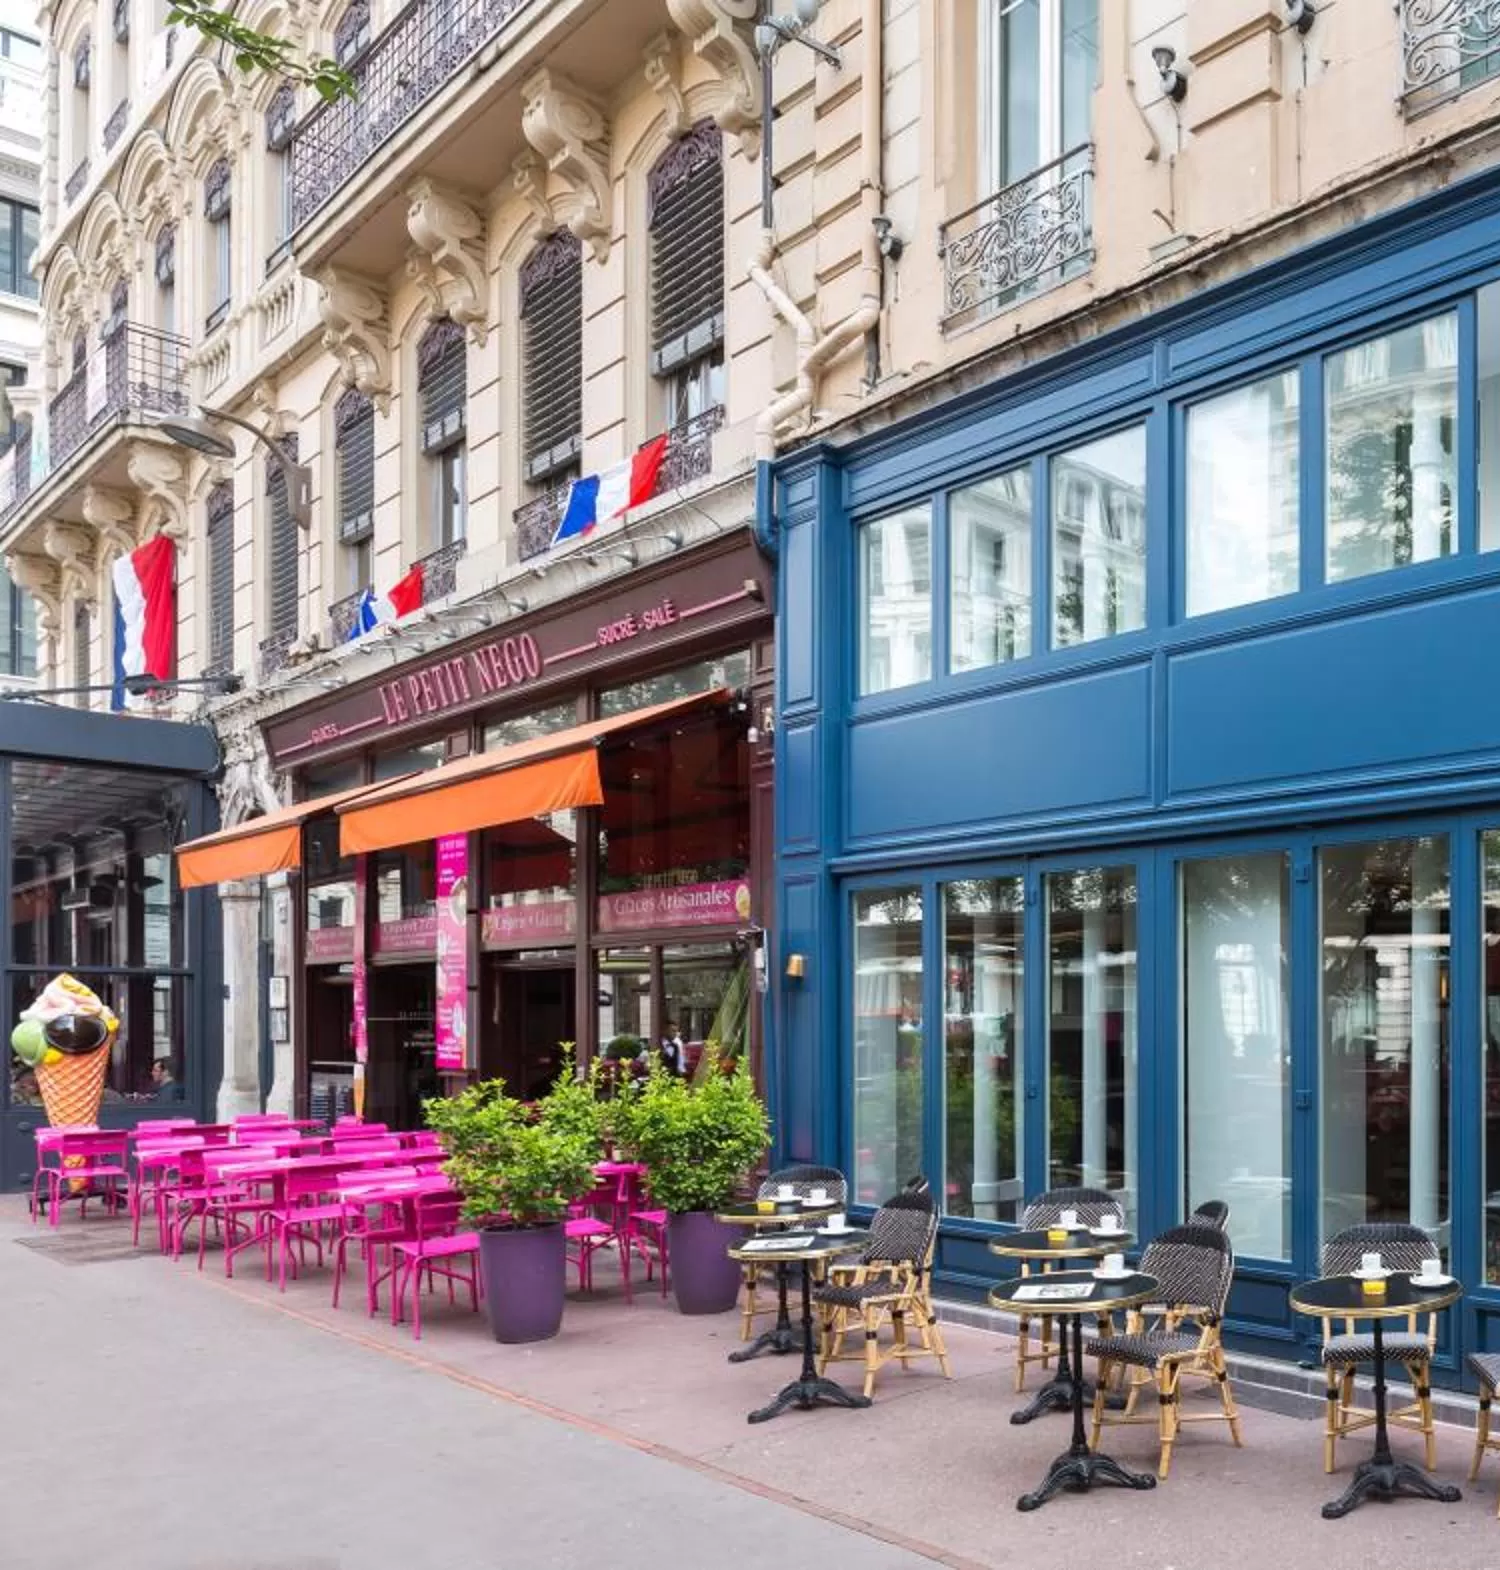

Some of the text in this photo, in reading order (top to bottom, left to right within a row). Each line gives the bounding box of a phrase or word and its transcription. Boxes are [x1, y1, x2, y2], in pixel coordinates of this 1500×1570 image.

[597, 612, 639, 646] SUCRÉ
[642, 599, 677, 631] SALÉ
[379, 632, 543, 725] LE PETIT NEGO
[656, 884, 732, 912] Artisanales
